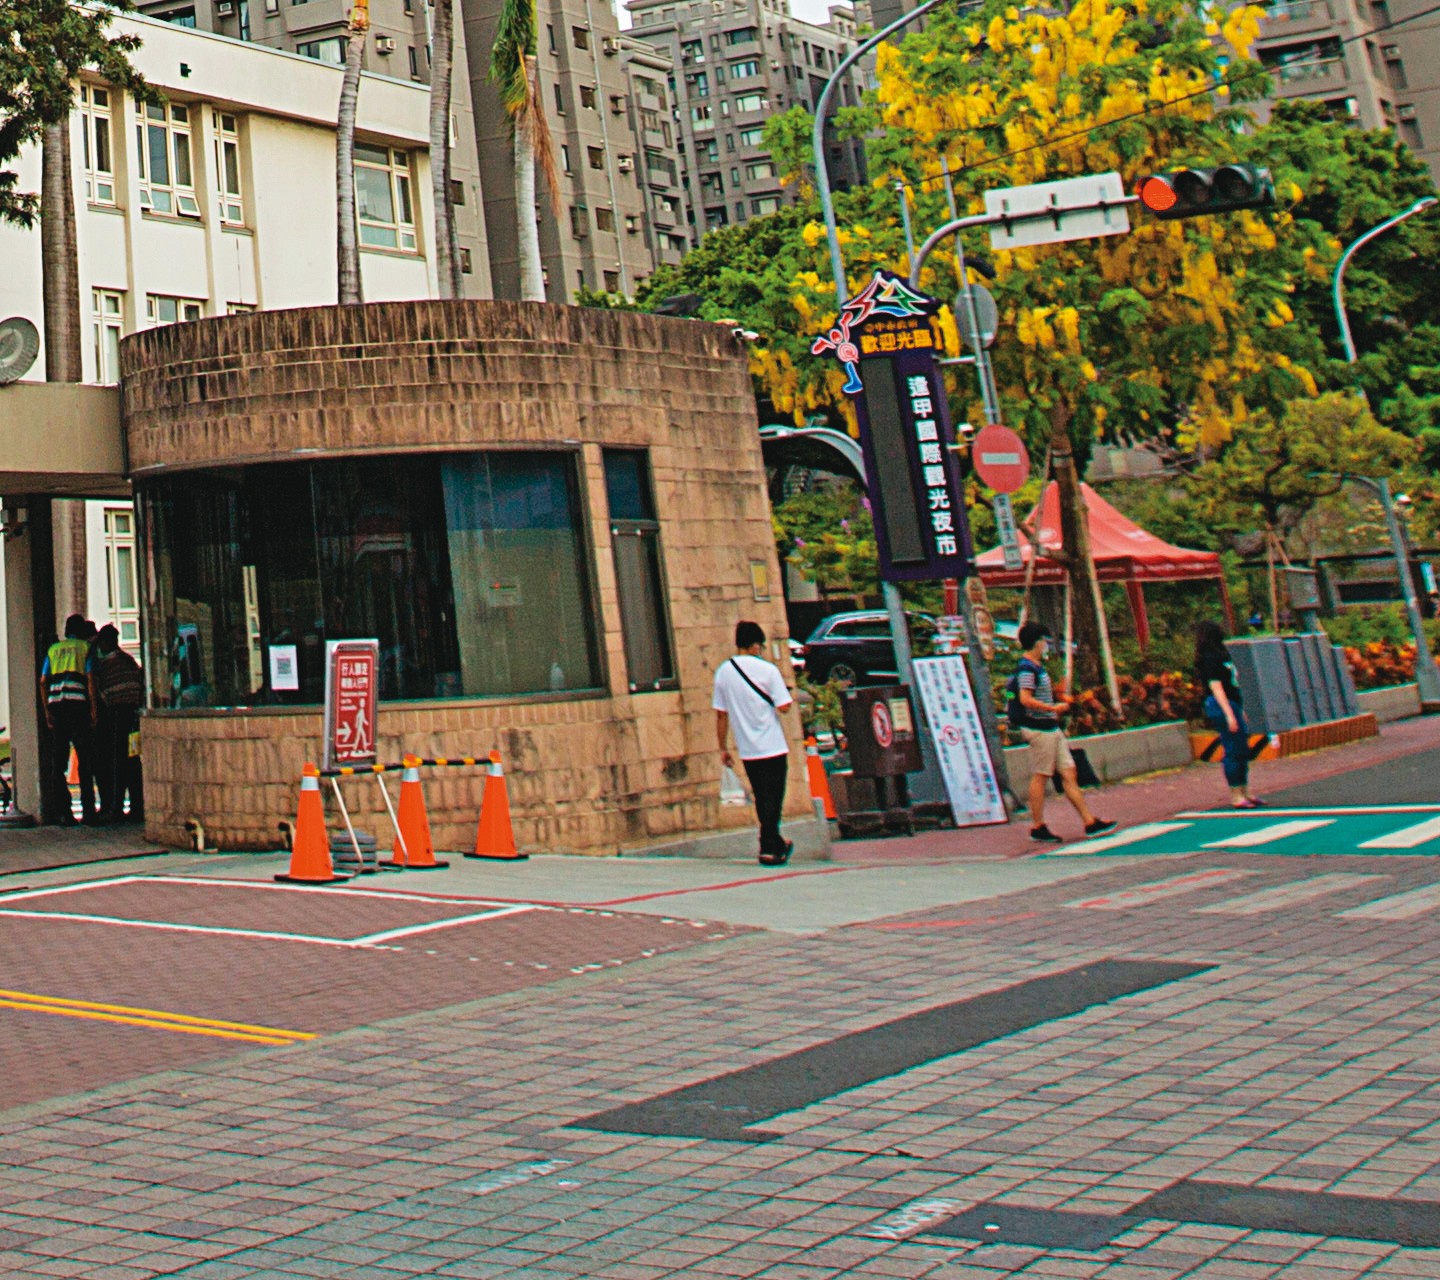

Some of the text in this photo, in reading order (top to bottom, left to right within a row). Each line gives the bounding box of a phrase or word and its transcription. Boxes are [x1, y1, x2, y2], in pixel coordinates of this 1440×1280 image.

[860, 329, 933, 354] 歡迎光臨
[906, 374, 958, 556] 逢甲國際觀光夜市
